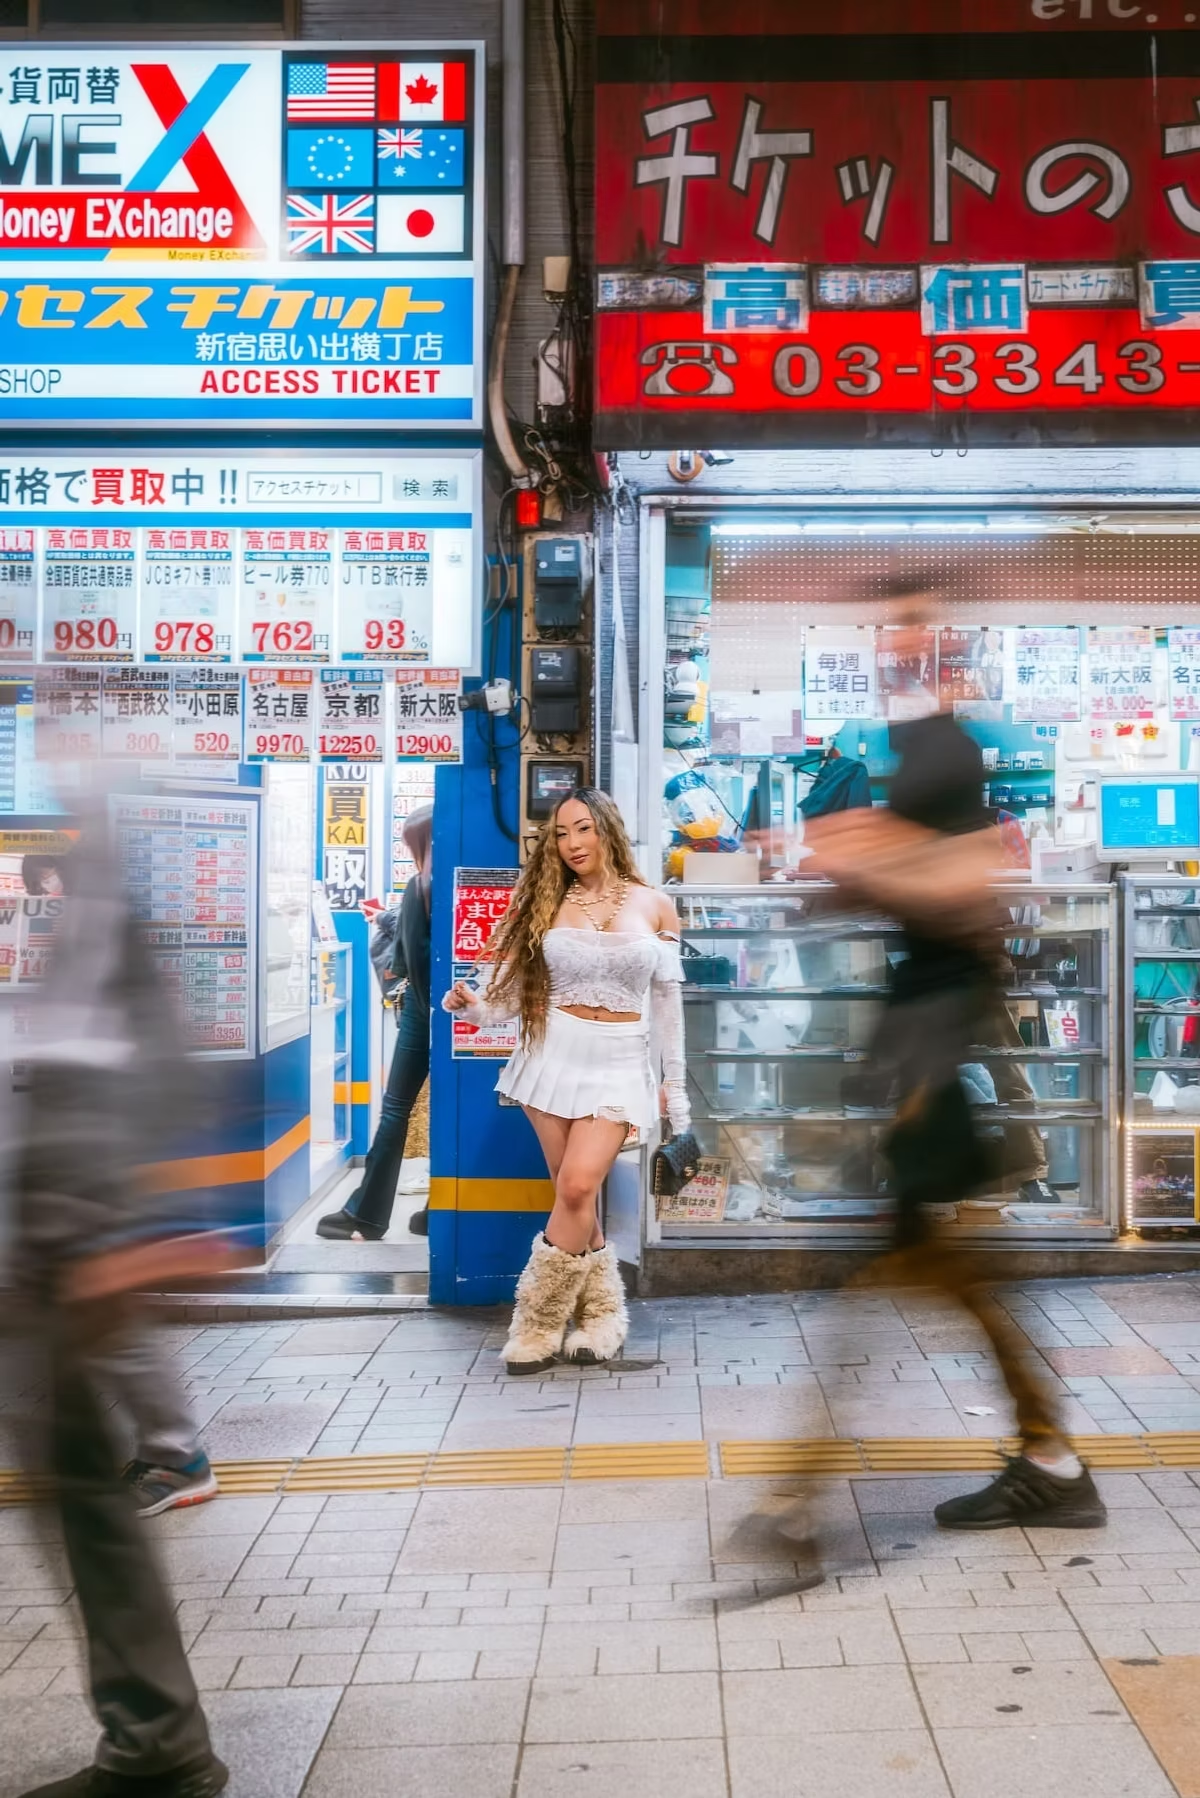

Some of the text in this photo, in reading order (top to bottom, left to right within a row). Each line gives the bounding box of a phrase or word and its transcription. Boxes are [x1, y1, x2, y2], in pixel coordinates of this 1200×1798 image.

[0, 68, 120, 105] 貨両替
[86, 198, 233, 244] EXchange
[168, 249, 204, 261] Money
[0, 285, 444, 328] セスチケット
[706, 267, 806, 329] 高
[924, 268, 1021, 331] 価
[195, 332, 443, 363] 新宿思い出横丁店
[201, 370, 441, 394] ACCESS TICKET
[253, 475, 354, 497] アクセスチケット
[403, 477, 450, 498] 検索
[48, 530, 132, 549] 高価買取
[148, 530, 230, 550] 高価買取
[245, 531, 329, 551] 高価買取
[343, 531, 427, 551] 高価買取
[343, 565, 427, 587] JTB旅行券
[818, 653, 860, 672] 毎週
[808, 674, 869, 693] 土曜日
[1090, 667, 1152, 684] 新大阪
[48, 692, 99, 716] 橋本
[117, 692, 169, 716] 西武秩父
[188, 692, 239, 717] 小田原
[252, 692, 309, 718] 名古屋
[324, 693, 380, 718] 京都
[400, 693, 457, 718] 新大阪
[326, 786, 366, 824] 買
[327, 825, 365, 845] KAI
[326, 850, 366, 889] 取
[327, 889, 357, 908] とり
